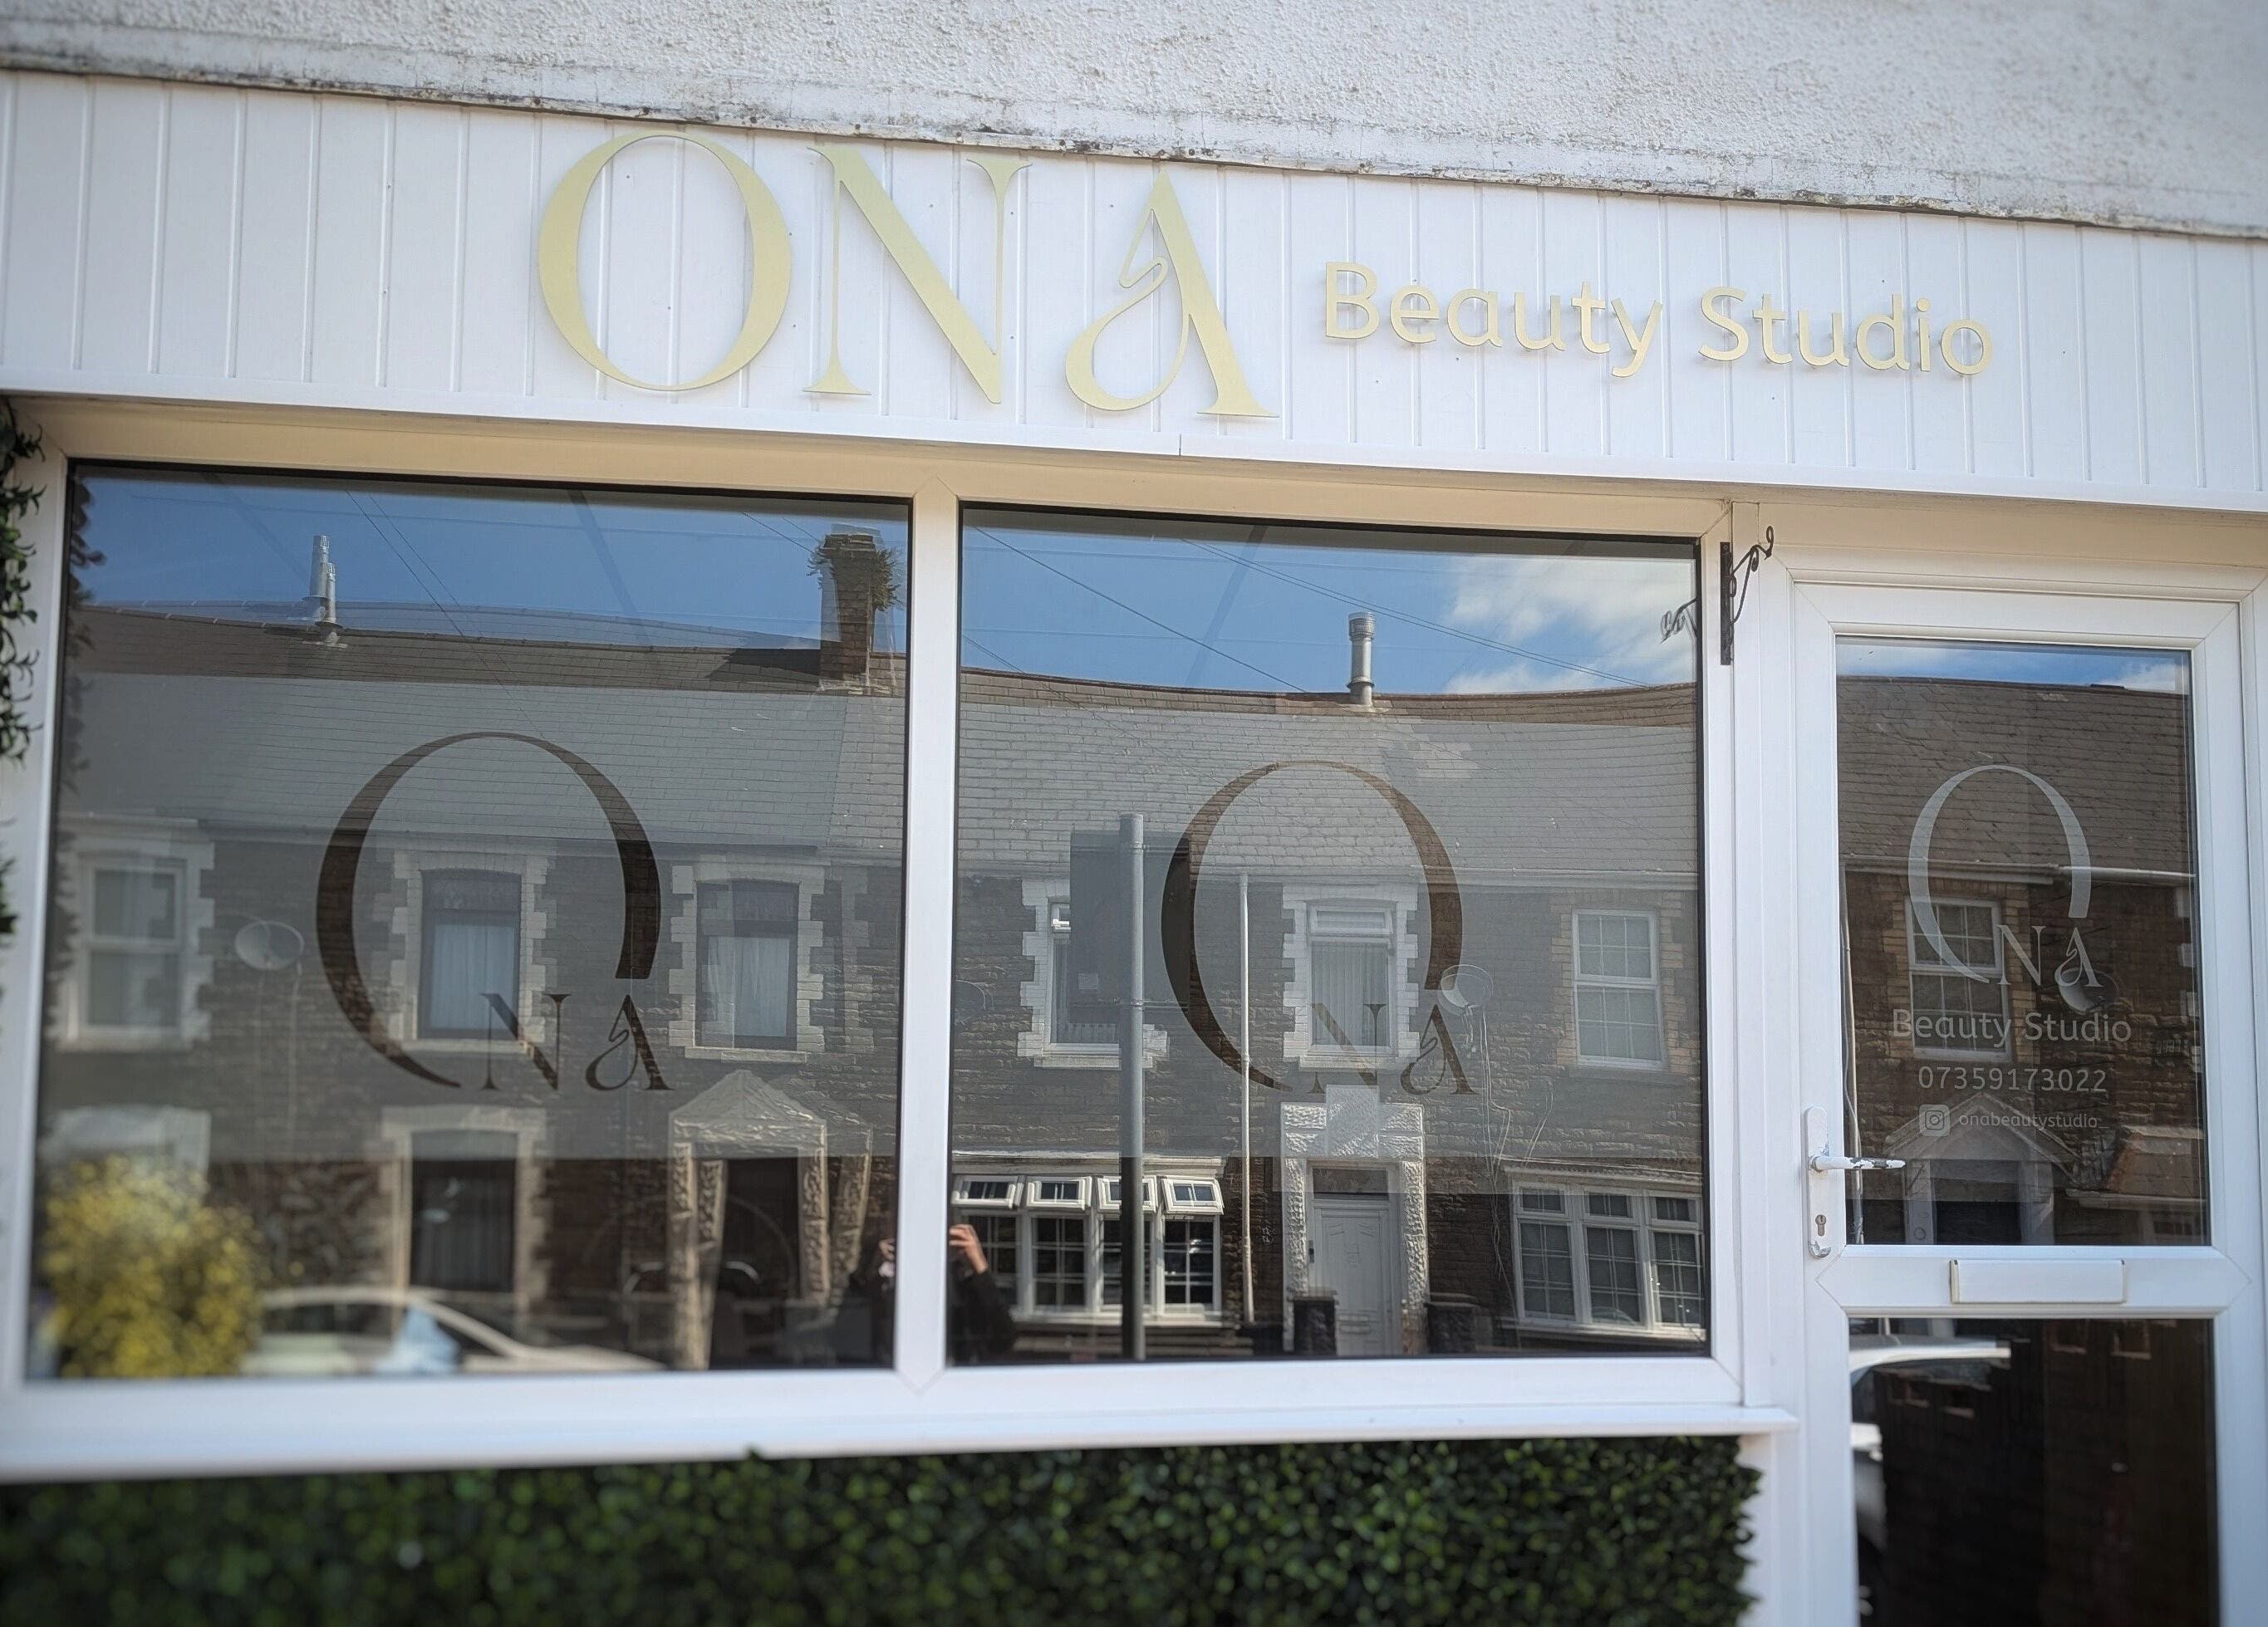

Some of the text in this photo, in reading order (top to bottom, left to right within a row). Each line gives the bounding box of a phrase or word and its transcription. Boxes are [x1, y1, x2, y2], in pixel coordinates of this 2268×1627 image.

[538, 129, 1279, 419] ONA
[1324, 261, 1992, 379] Beauty Studio
[1892, 1008, 2132, 1048] Beauty Studio
[1917, 1066, 2108, 1092] 07359173022
